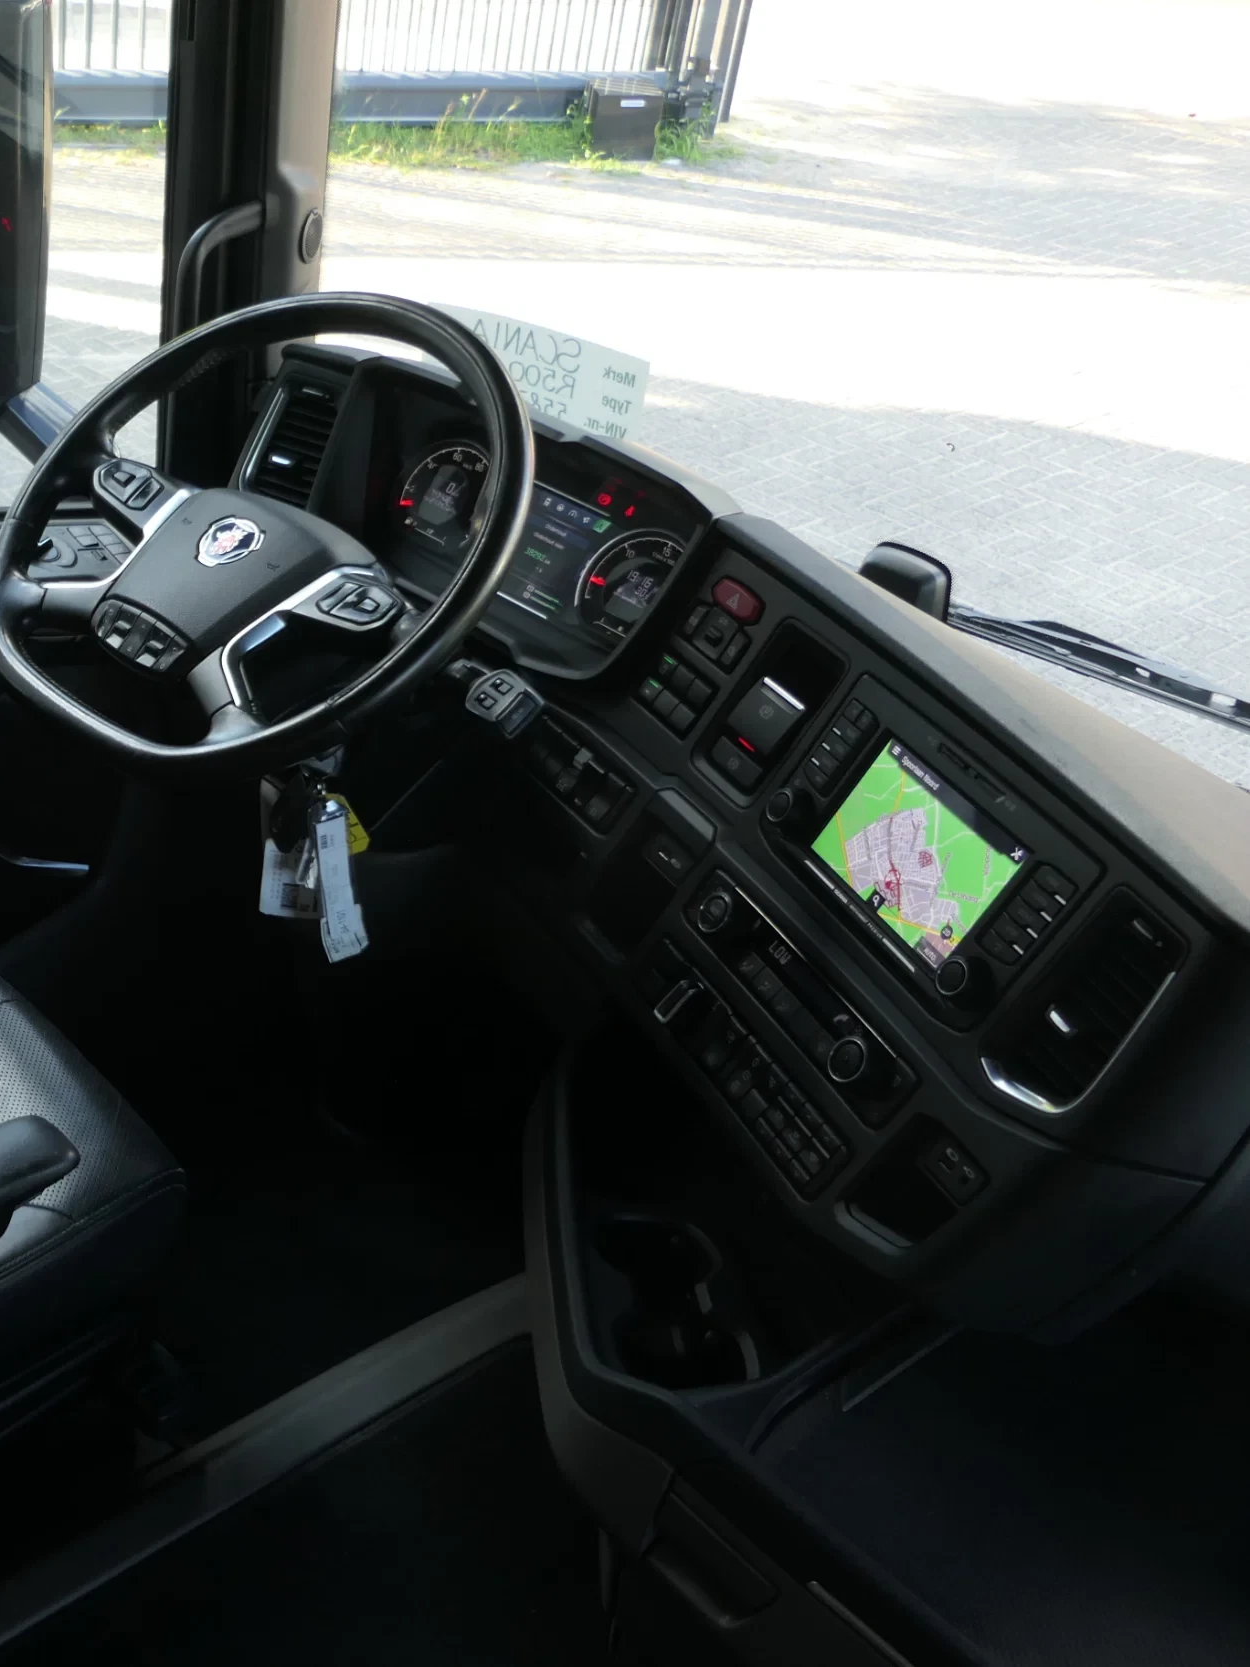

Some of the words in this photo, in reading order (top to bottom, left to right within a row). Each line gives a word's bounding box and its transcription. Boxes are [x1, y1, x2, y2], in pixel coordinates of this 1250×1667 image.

[451, 451, 463, 462] 60
[625, 548, 635, 559] 10
[661, 547, 672, 557] 15
[767, 938, 793, 966] LOW
[922, 947, 937, 961] AUTO
